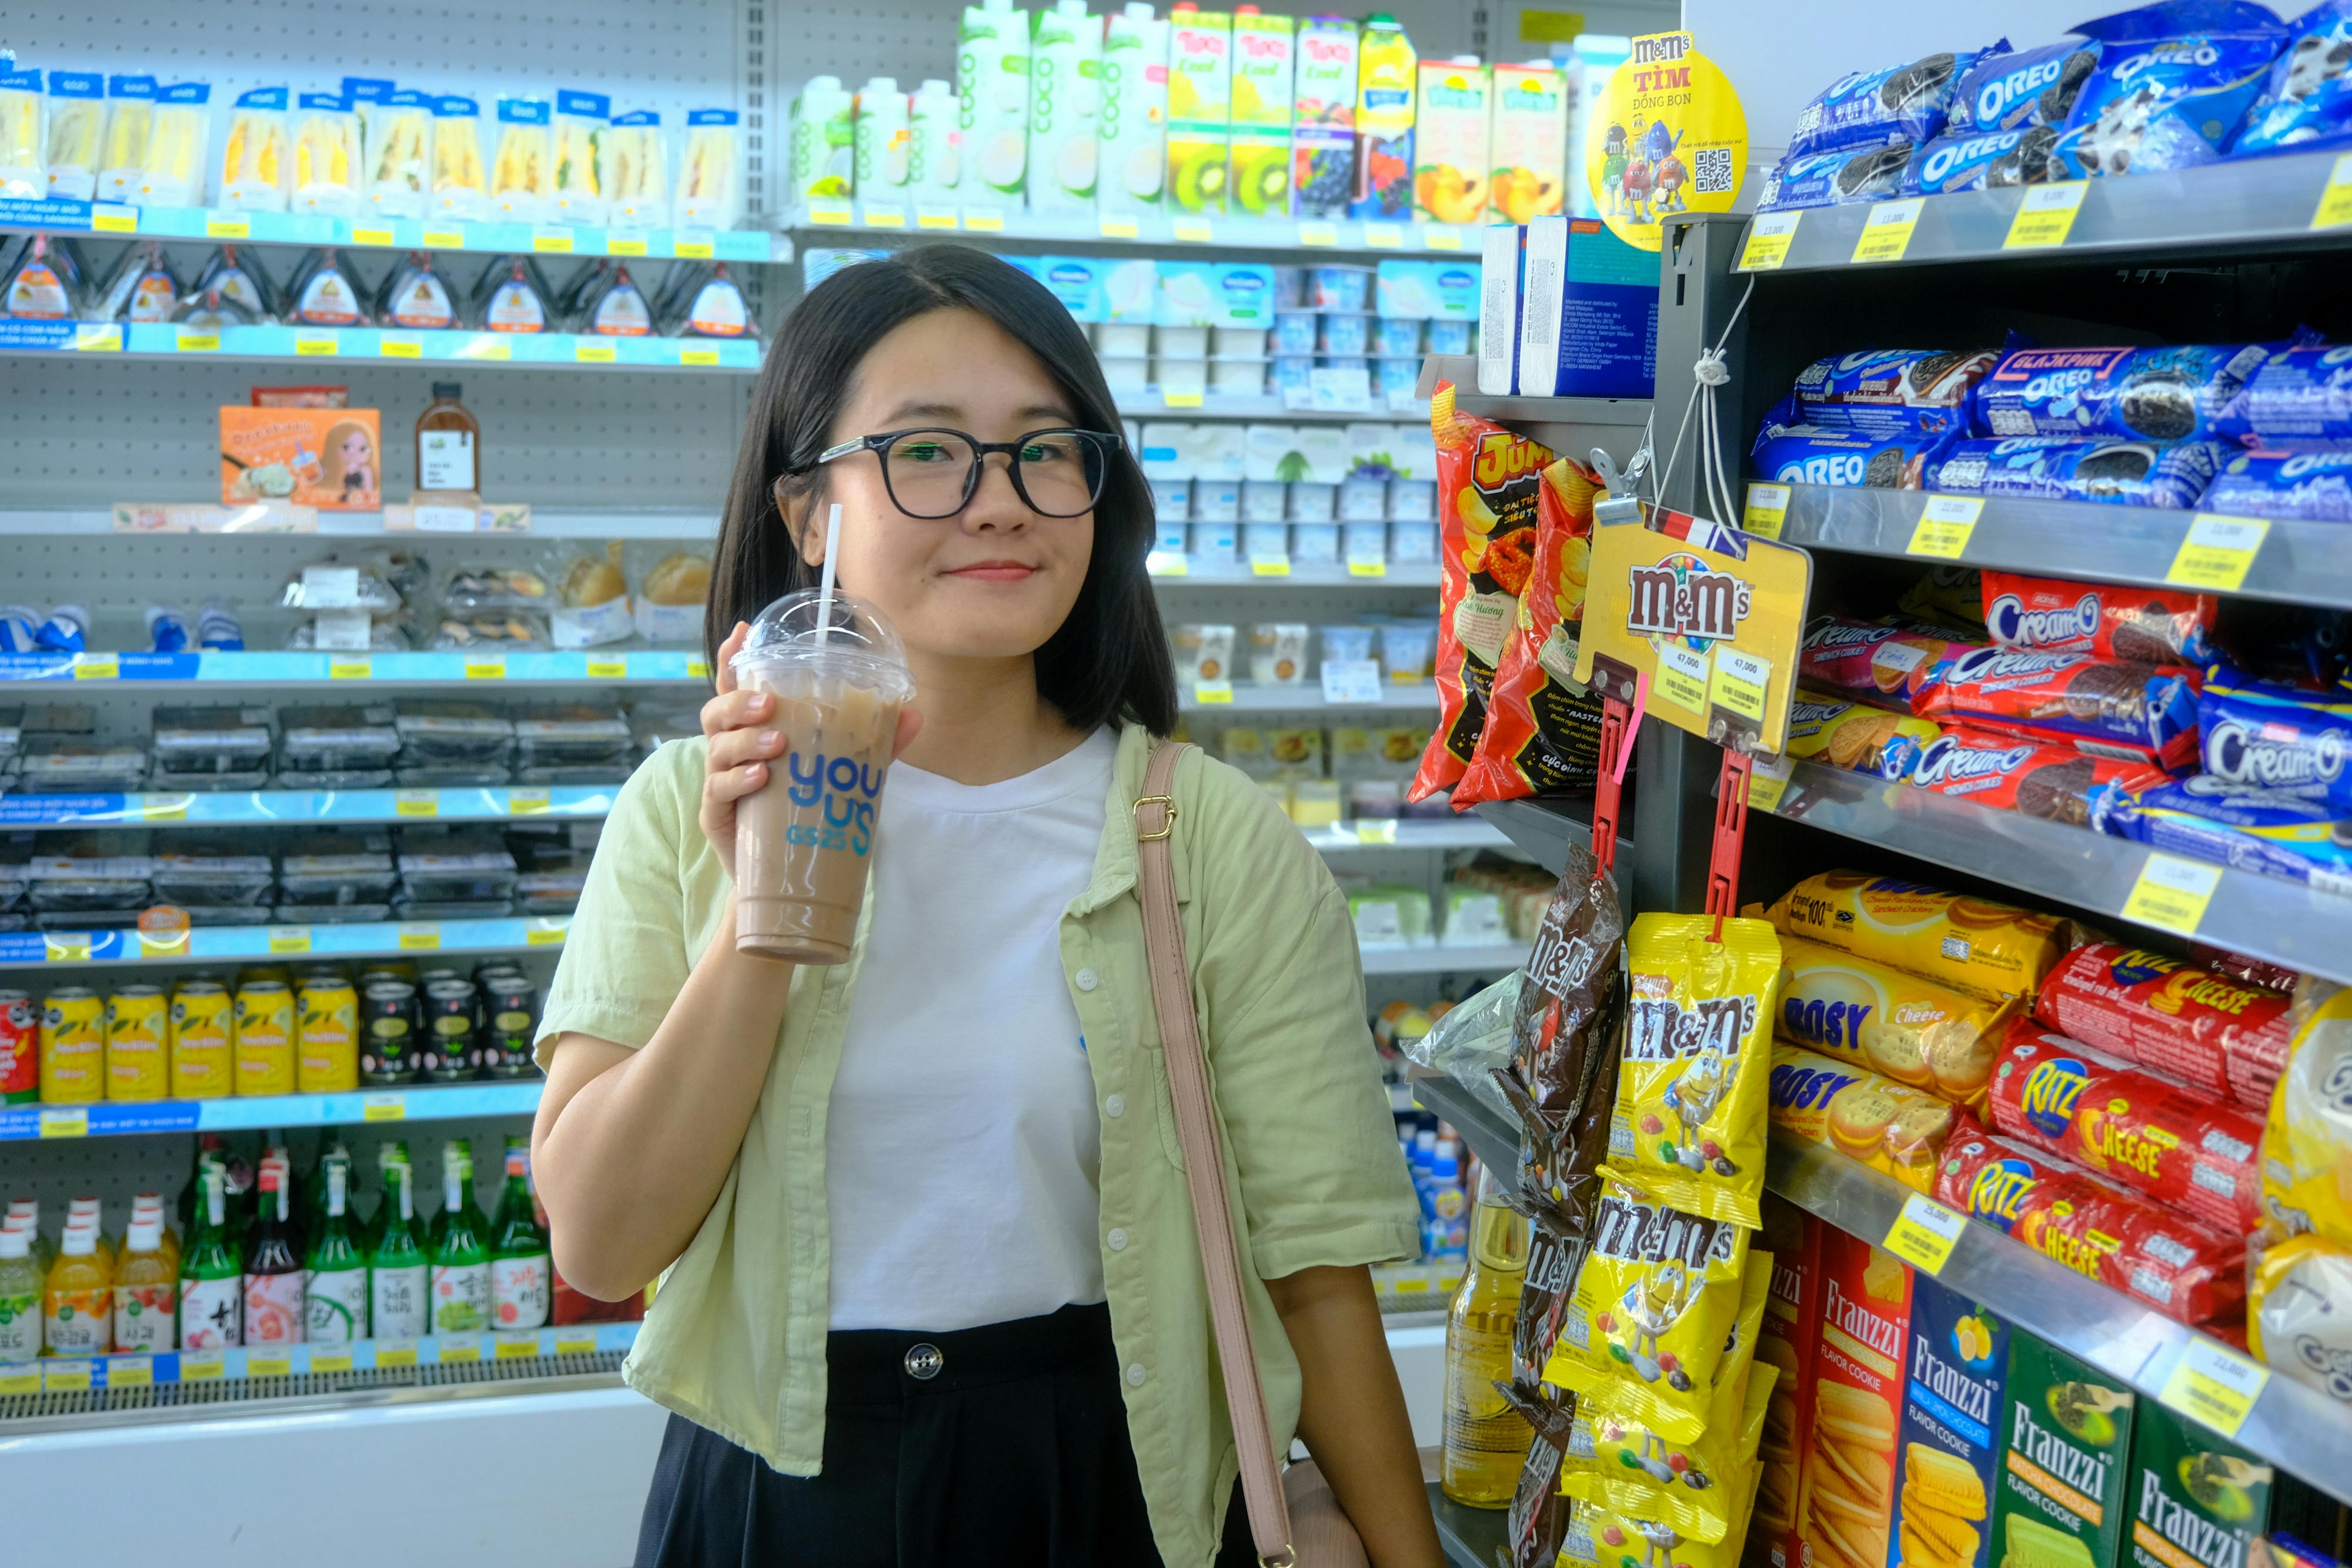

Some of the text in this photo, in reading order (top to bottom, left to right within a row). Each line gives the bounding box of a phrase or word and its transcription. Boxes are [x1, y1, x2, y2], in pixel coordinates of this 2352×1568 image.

[1633, 65, 1692, 93] TÌM
[2111, 45, 2217, 80] OREO
[1667, 93, 1692, 107] BỌN
[1978, 60, 2061, 122] OREO
[1923, 132, 2020, 182] OREO
[1763, 225, 1784, 236] 13,000
[2024, 369, 2093, 403] OREO
[1475, 603, 1504, 620] Hương
[1987, 593, 2100, 646] Cream-O
[1676, 652, 1699, 669] 47,000
[1734, 658, 1758, 674] 47,000
[1912, 734, 2038, 789] Cream-O
[2207, 720, 2345, 785] Cream-O
[788, 752, 882, 807] you
[786, 824, 848, 851] GS25
[1808, 899, 1826, 927] 100
[1872, 905, 1902, 913] Sandwich
[1895, 1007, 1946, 1024] Cheese
[2021, 1061, 2090, 1120] RITZ
[1809, 1116, 1825, 1125] Cream
[1967, 1162, 2037, 1221] RITZ
[1923, 1204, 1950, 1223] 25,000
[1825, 1277, 1901, 1360] Franzzi
[1821, 1343, 1882, 1392] FLAVOR COOKIE
[1848, 1340, 1892, 1376] CHOCOLATE
[1912, 1333, 1992, 1425] Franzzi
[1909, 1404, 1970, 1457] FLAVOR COOKIE
[1947, 1409, 1986, 1443] CHOCOLATE
[2011, 1400, 2105, 1502] Franzzi
[2007, 1473, 2082, 1532] FLAVOR COOKIE
[2043, 1475, 2100, 1521] CHOCOLATE
[2138, 1467, 2242, 1568] Franzzi
